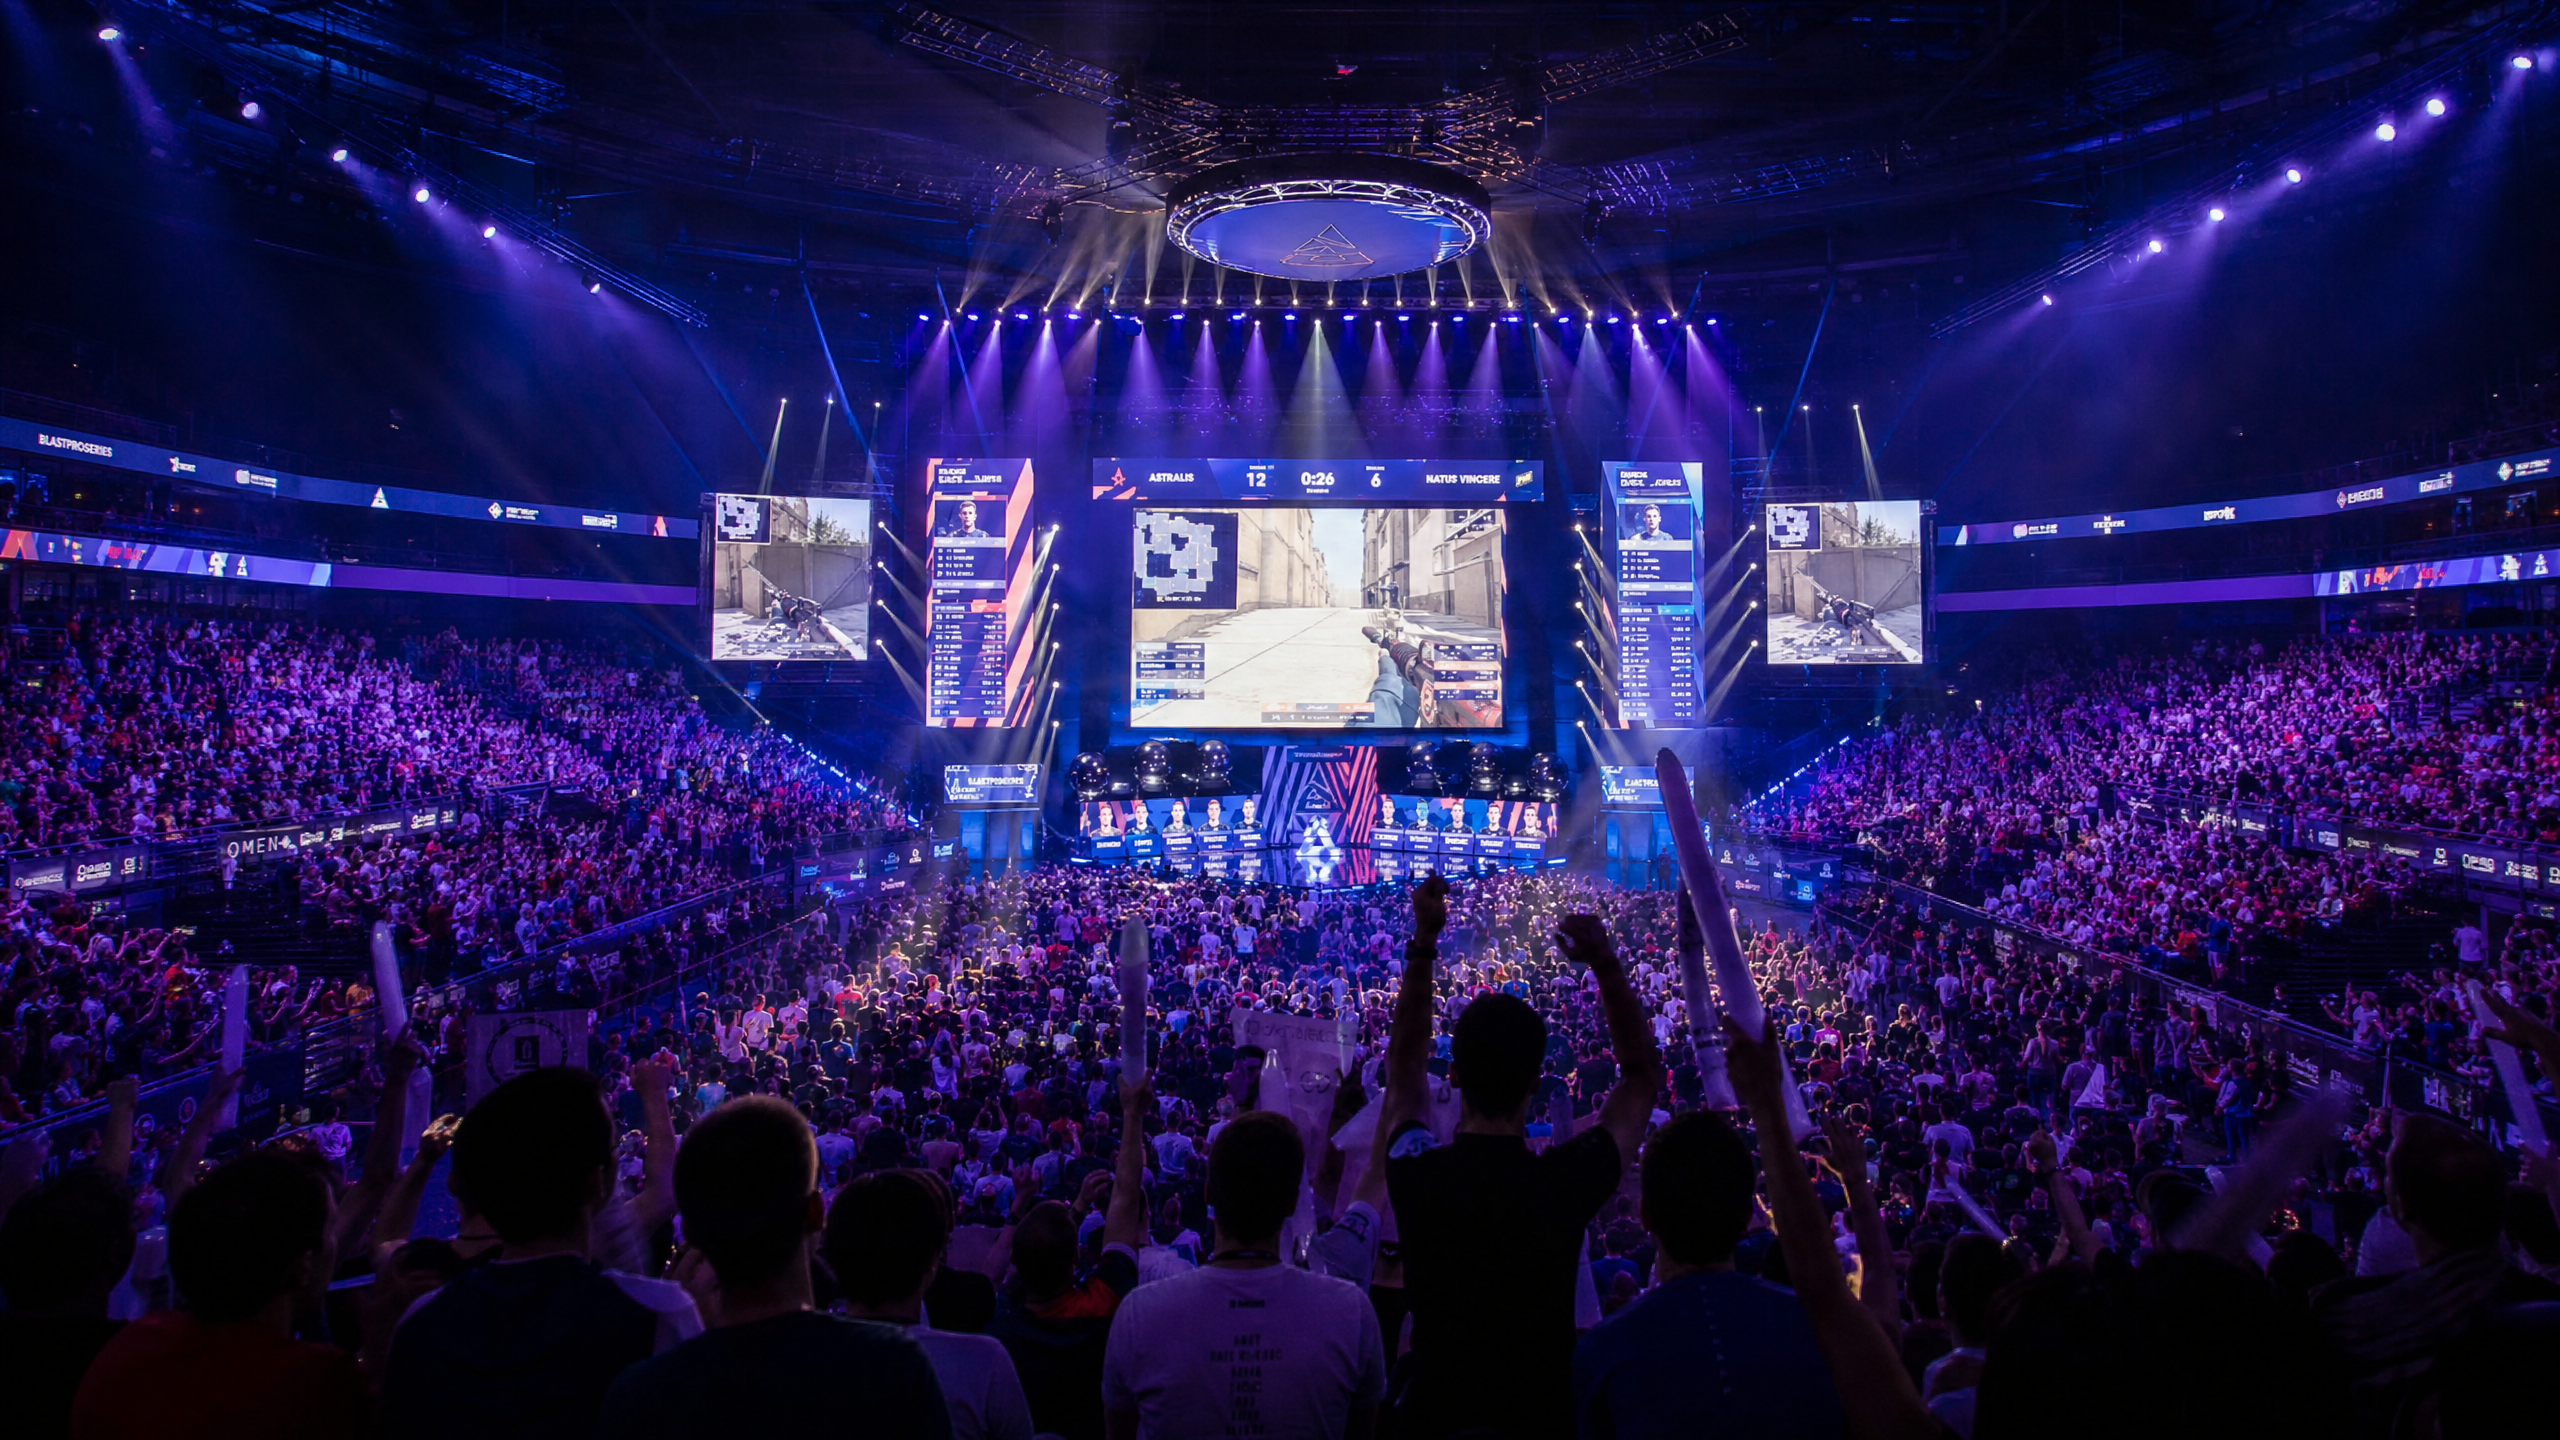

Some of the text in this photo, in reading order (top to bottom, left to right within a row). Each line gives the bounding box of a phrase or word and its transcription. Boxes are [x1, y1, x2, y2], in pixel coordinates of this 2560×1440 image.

[38, 433, 113, 457] BLASTPROSERIES
[1149, 473, 1195, 482] ASTRALIS
[1246, 473, 1266, 487] 12
[1301, 472, 1335, 485] 0:26
[1370, 473, 1381, 488] 6
[1426, 475, 1500, 484] NATUS VINCERE
[227, 836, 278, 858] OMEN
